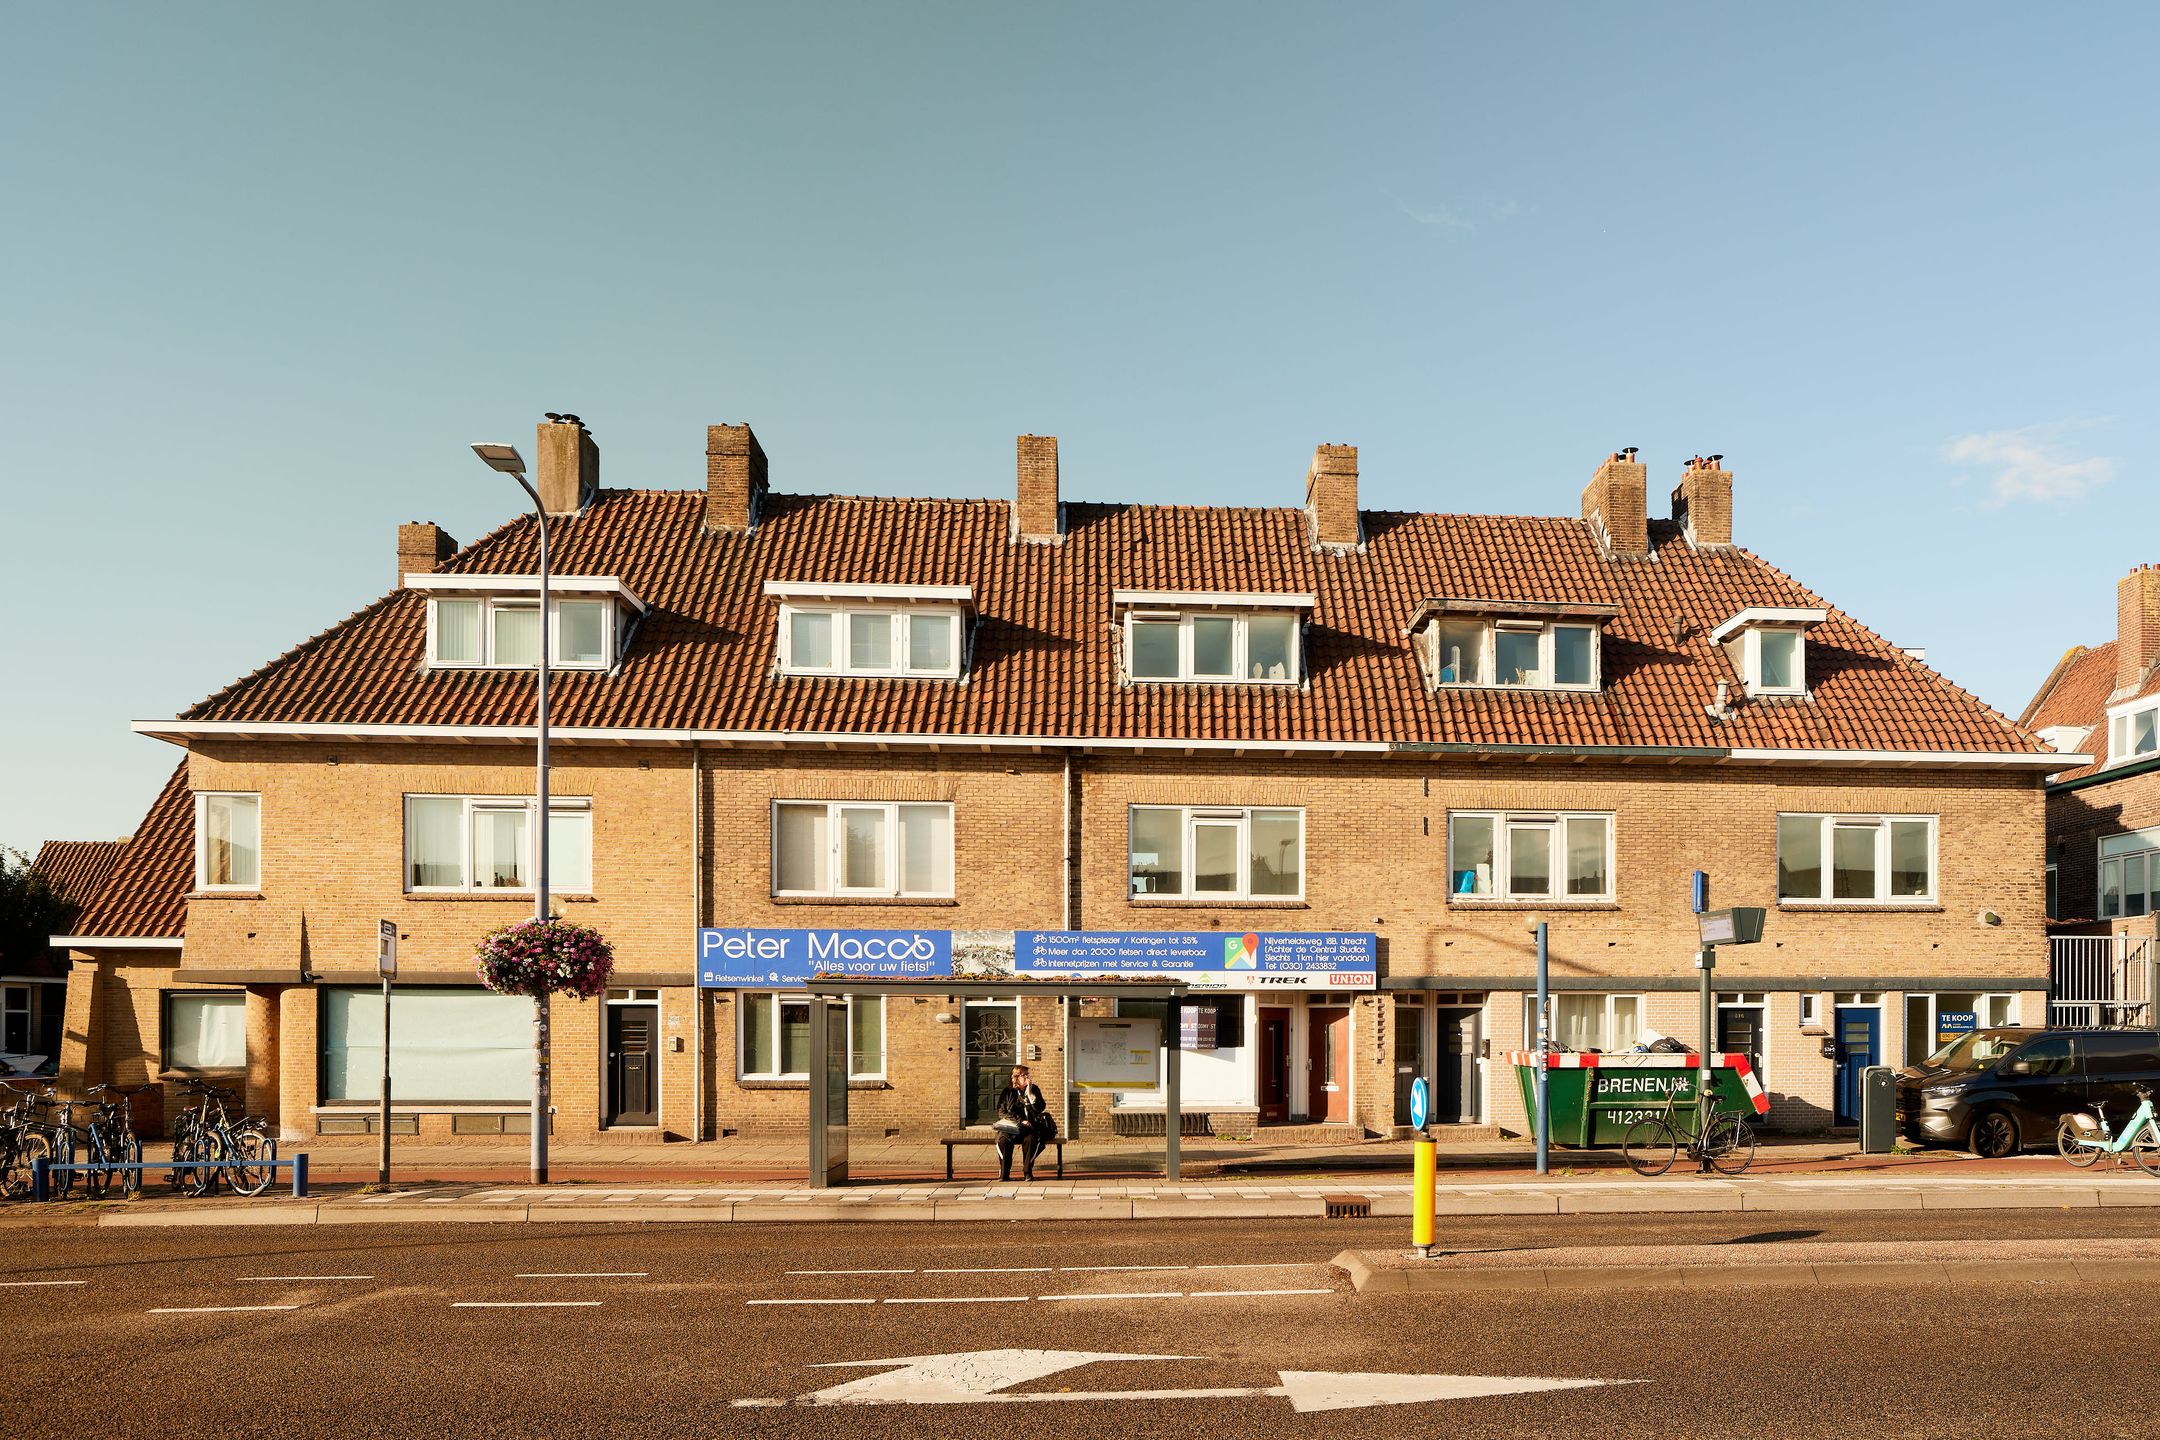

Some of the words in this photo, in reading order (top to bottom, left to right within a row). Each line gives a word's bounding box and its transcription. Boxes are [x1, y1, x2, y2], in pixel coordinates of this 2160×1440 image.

[1082, 935, 1120, 945] fietsplezier
[1131, 936, 1166, 946] Kortingen
[1169, 936, 1179, 944] tot
[1182, 936, 1198, 944] 35%
[1228, 940, 1238, 950] G
[1264, 937, 1322, 947] Nijverheidsweg
[1340, 937, 1367, 945] Utrecht
[703, 931, 790, 959] Peter
[808, 932, 935, 960] Macco
[1048, 948, 1068, 956] Meer
[1072, 948, 1087, 956] dan
[1090, 948, 1116, 956] 2000
[1119, 948, 1144, 956] fietsen
[1146, 948, 1167, 956] direct
[1170, 948, 1207, 957] leverbaar
[1264, 954, 1291, 962] Slechts
[1316, 954, 1330, 962] hier
[1333, 954, 1370, 962] vandaan)
[808, 960, 844, 971] "Alles
[848, 962, 876, 972] voor
[879, 963, 897, 972] uw
[901, 960, 935, 972] fiets!"
[1048, 960, 1099, 969] Internetprijzen
[1103, 960, 1117, 968] met
[1120, 960, 1149, 968] Service
[1151, 960, 1158, 968] &
[1161, 960, 1194, 968] Garantie
[1280, 962, 1303, 970] (030)
[1258, 976, 1308, 984] TREK
[1331, 975, 1372, 984] UNION
[1941, 1014, 1950, 1022] TE
[1951, 1014, 1973, 1022] KOOP
